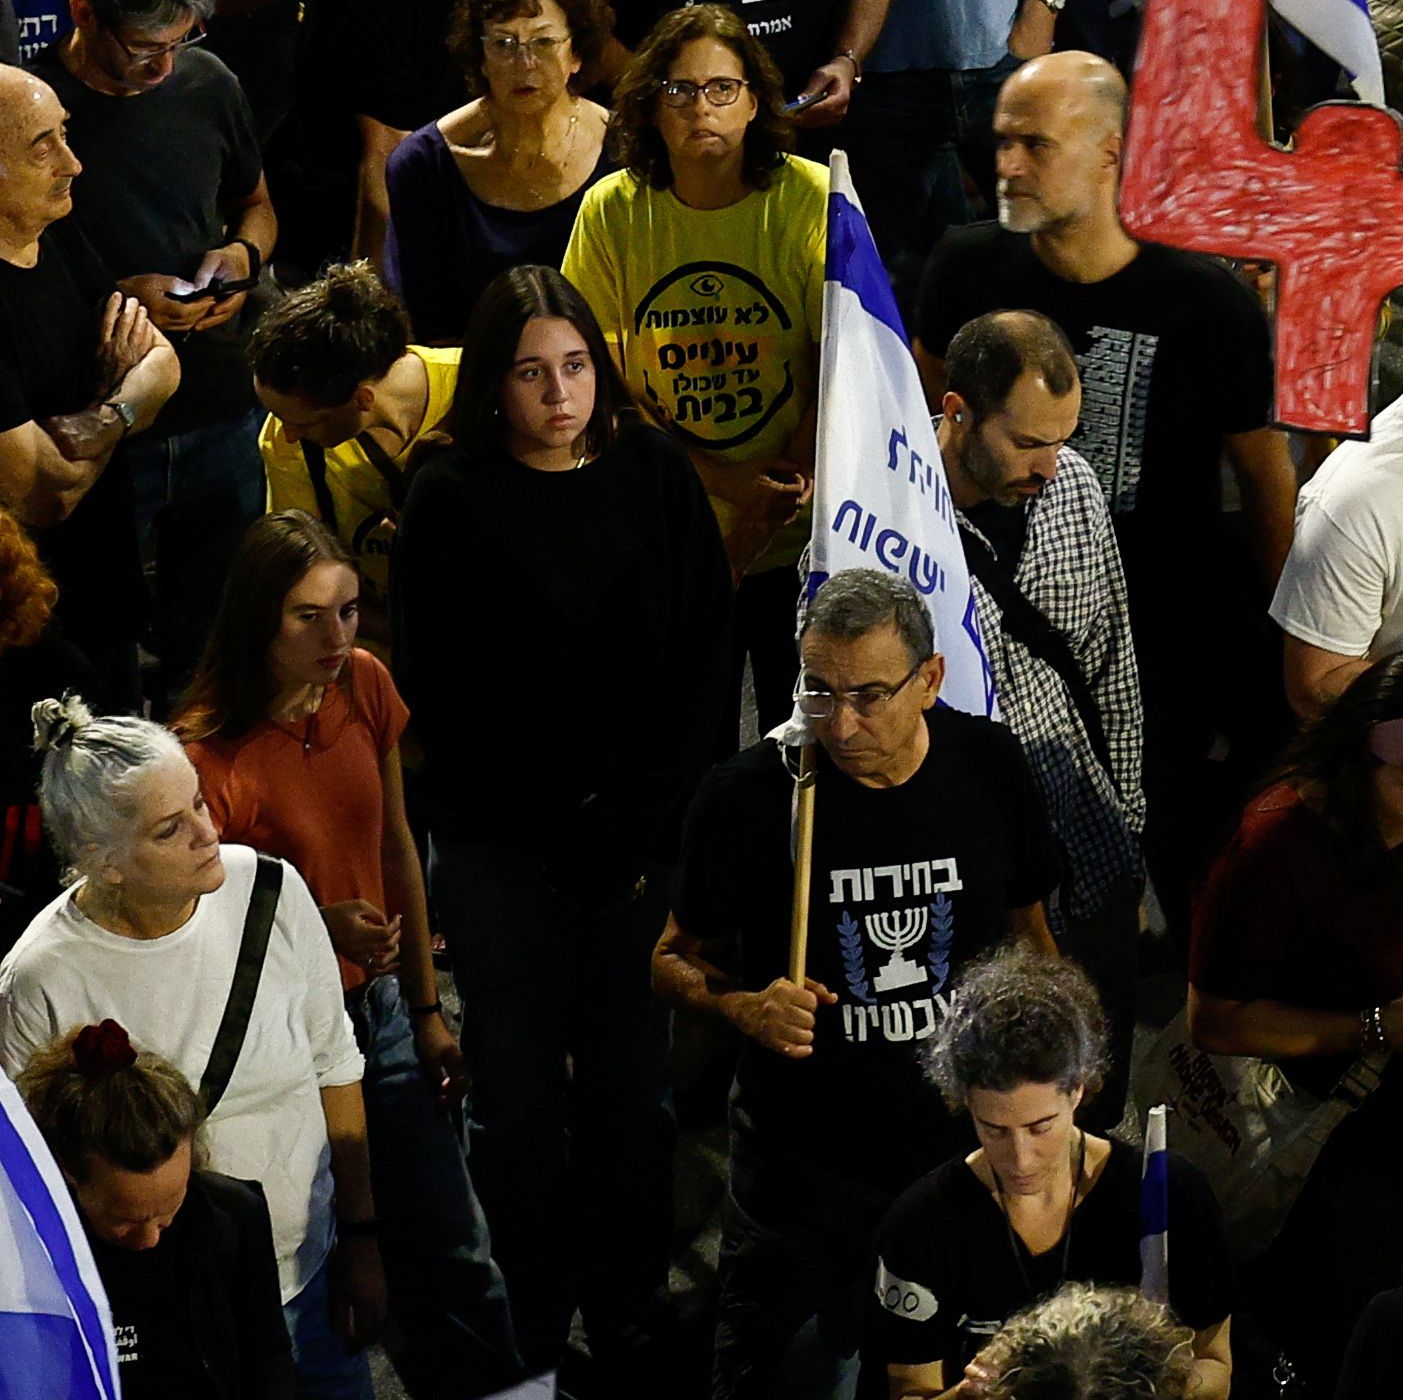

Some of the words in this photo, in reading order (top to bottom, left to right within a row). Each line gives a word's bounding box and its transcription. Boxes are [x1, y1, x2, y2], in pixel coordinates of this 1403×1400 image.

[645, 305, 730, 330] עוצמות
[735, 302, 769, 325] לא
[657, 338, 759, 371] עיניים
[733, 369, 760, 386] עד
[675, 387, 764, 424] בבית
[828, 856, 963, 904] בחירות
[841, 989, 959, 1043] עכשיו!
